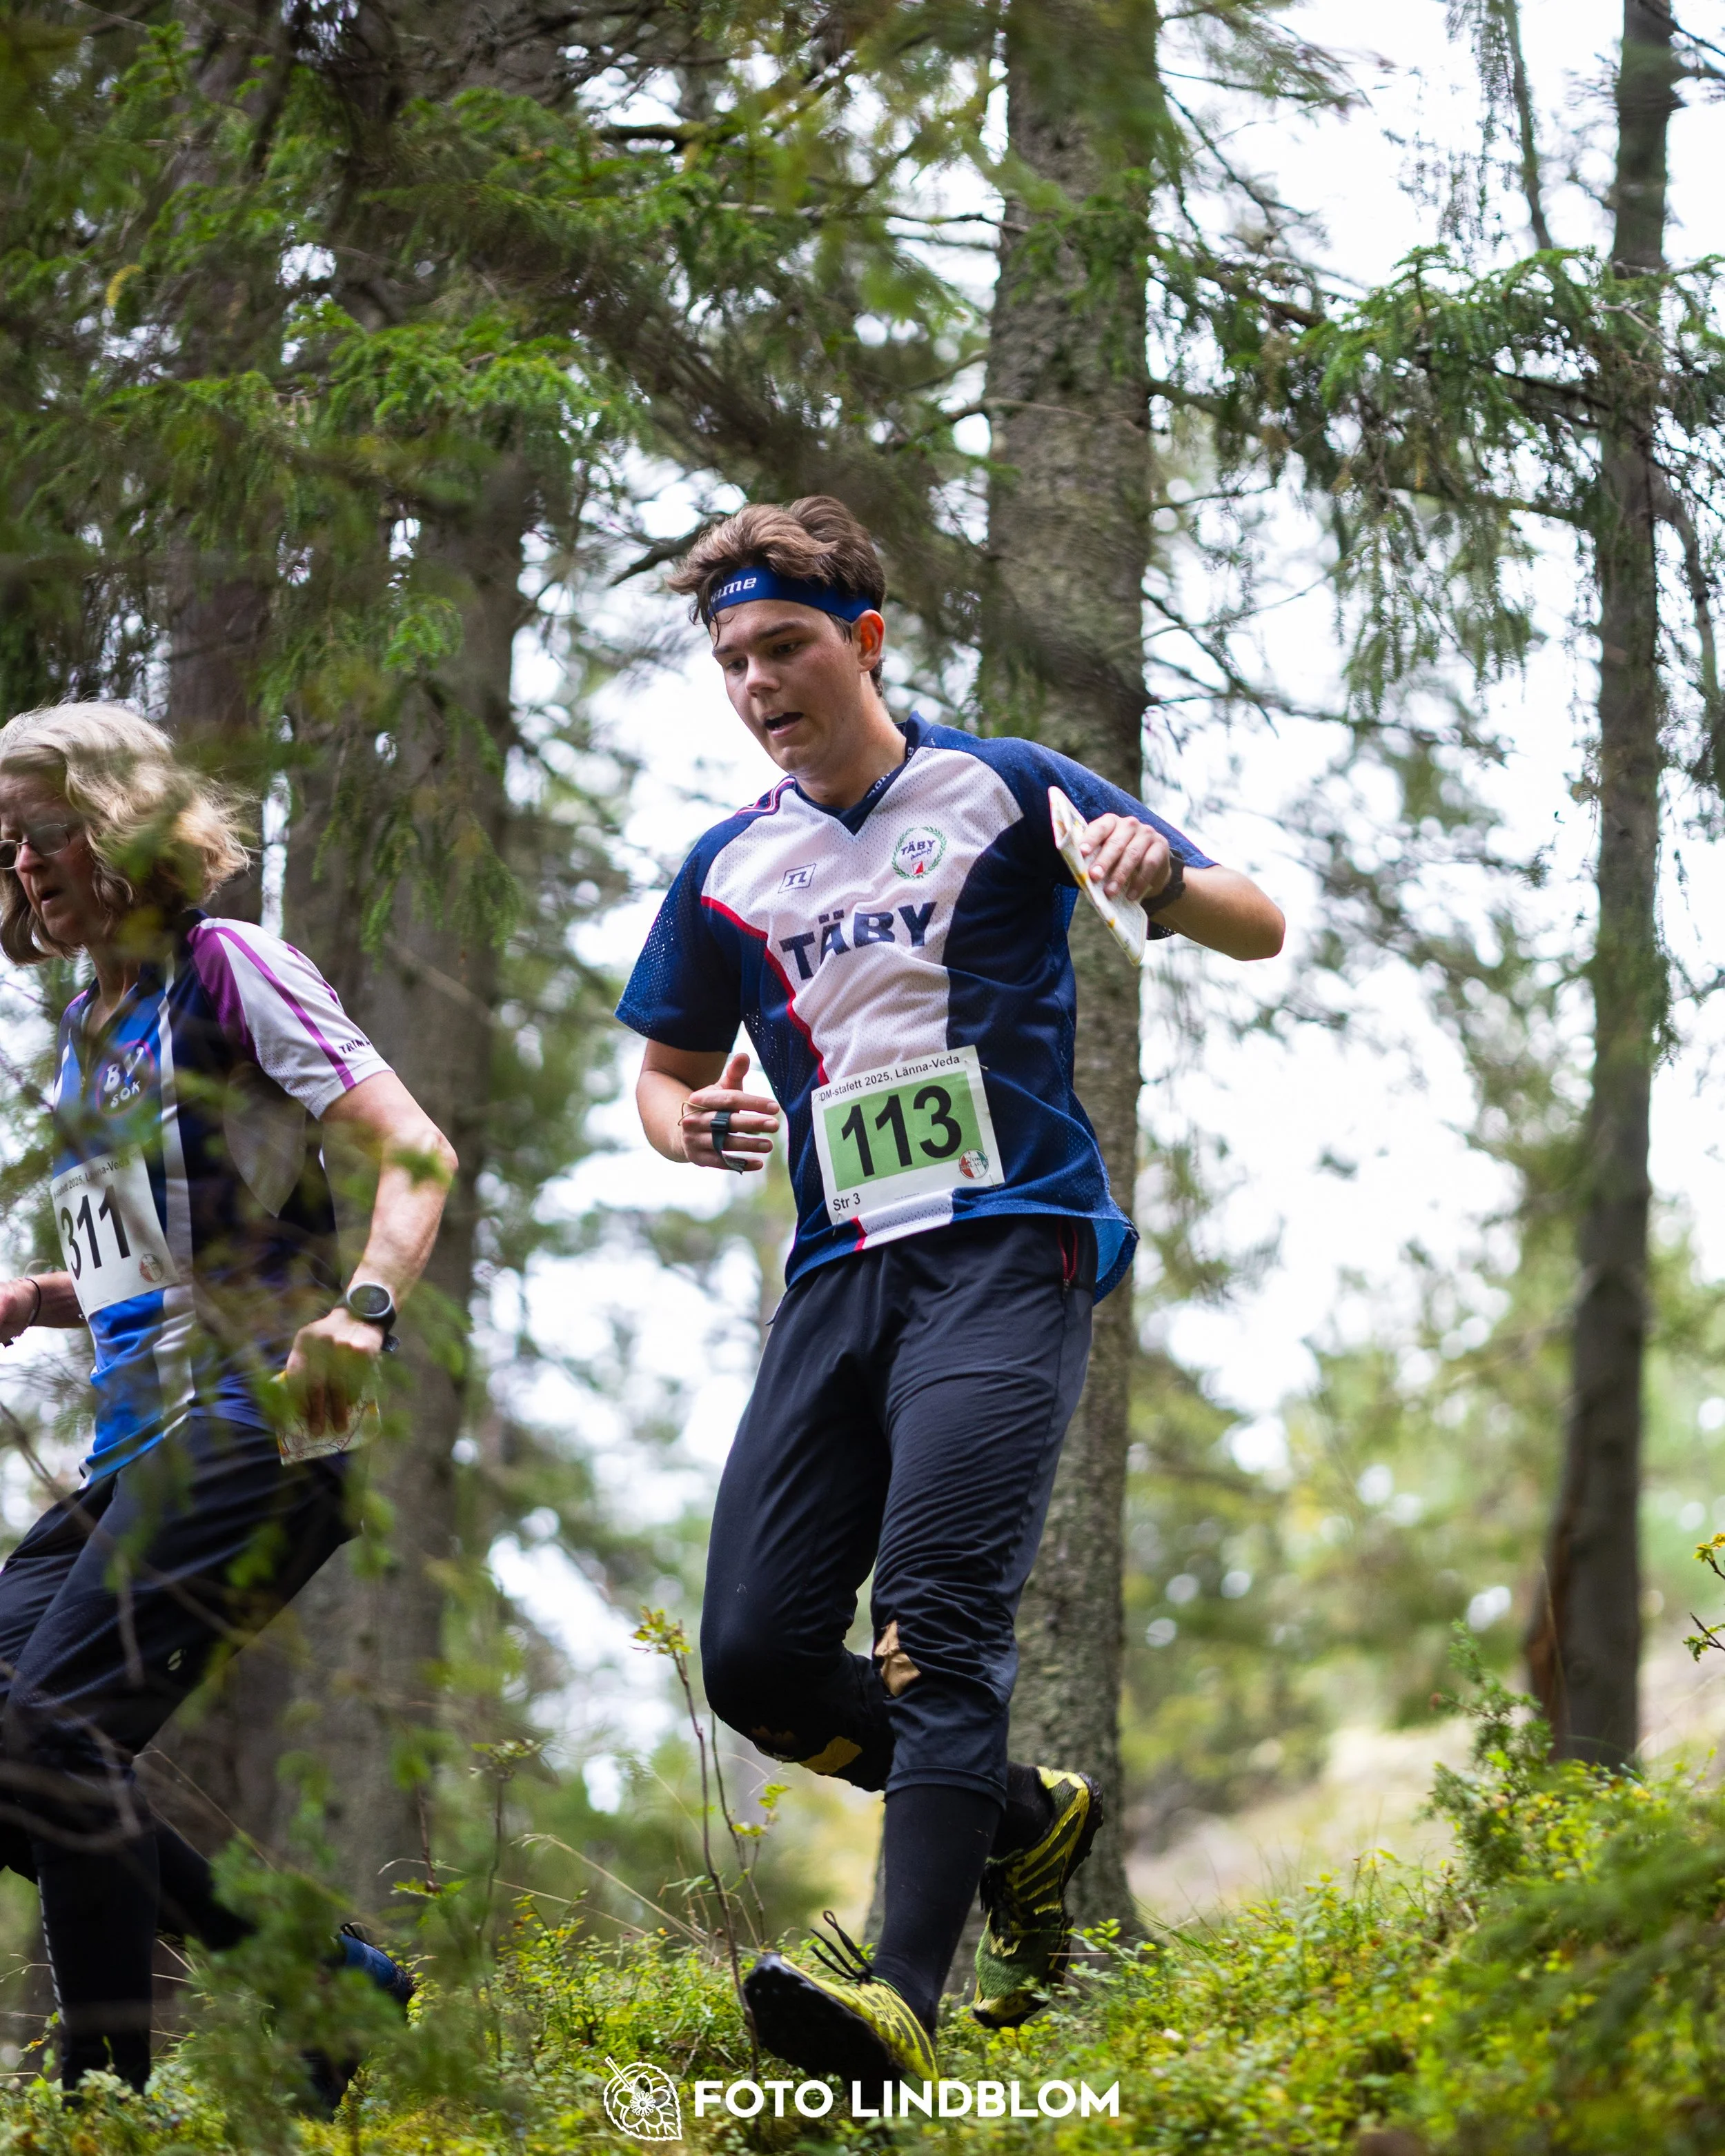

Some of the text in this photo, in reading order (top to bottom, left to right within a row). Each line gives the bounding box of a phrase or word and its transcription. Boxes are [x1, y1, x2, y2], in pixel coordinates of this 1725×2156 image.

[900, 840, 936, 856] TÄBY
[778, 901, 937, 980] TÄBY
[110, 1080, 141, 1108] SOK
[819, 1055, 960, 1102] DM-stafett 2025, Länna-Veda
[840, 1085, 963, 1178] 113
[832, 1192, 861, 1211] Str 3
[60, 1185, 132, 1281] 311
